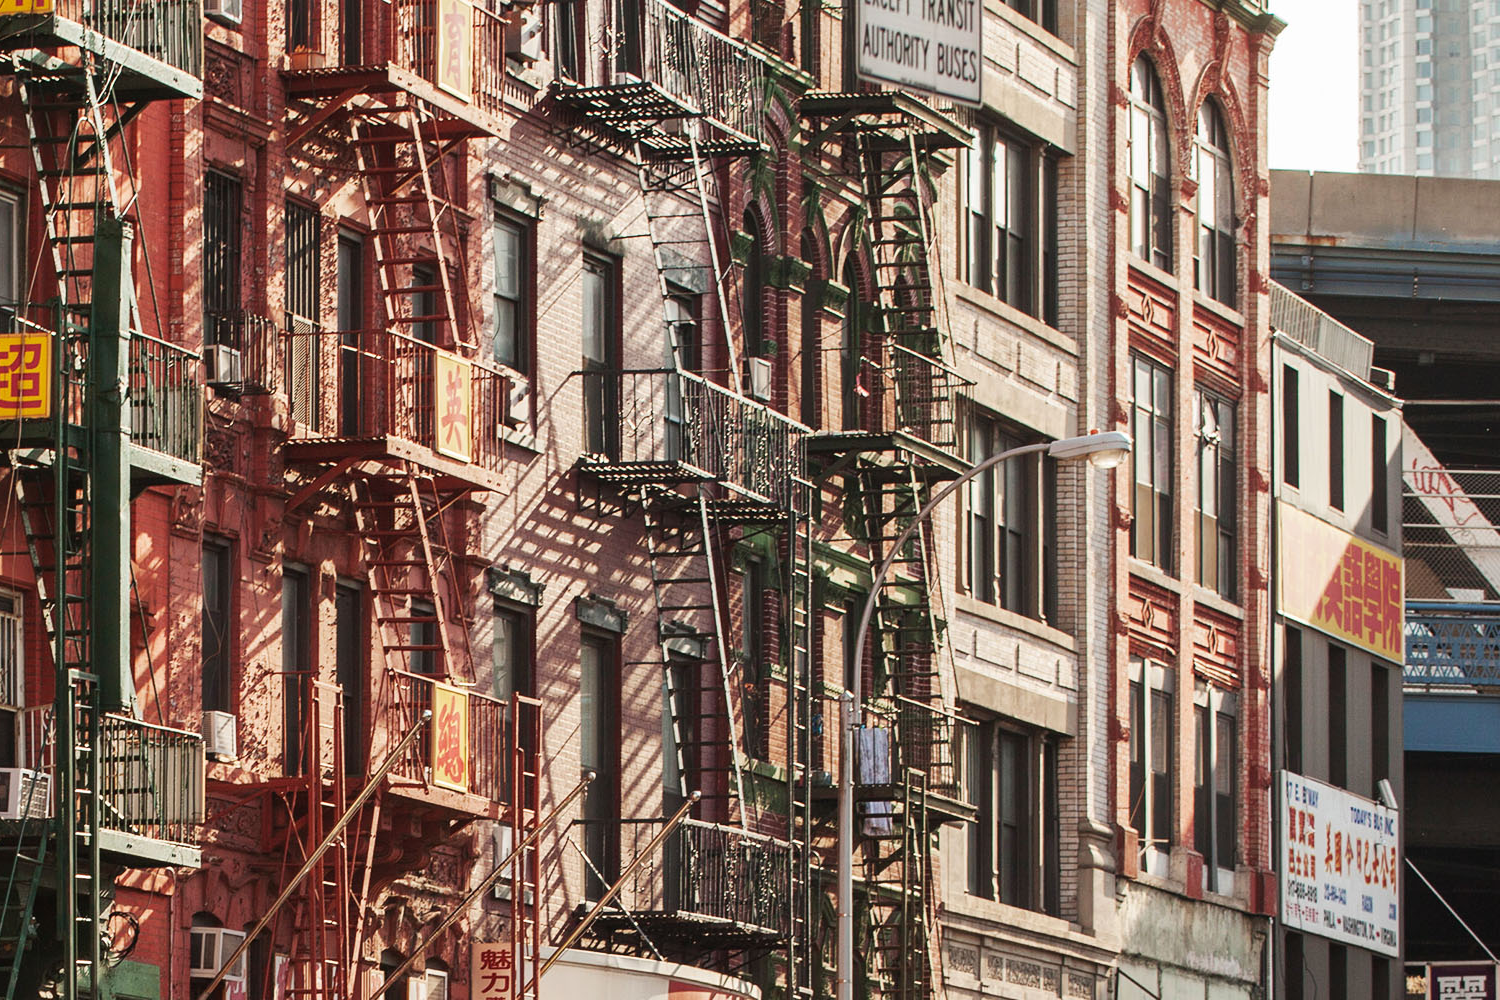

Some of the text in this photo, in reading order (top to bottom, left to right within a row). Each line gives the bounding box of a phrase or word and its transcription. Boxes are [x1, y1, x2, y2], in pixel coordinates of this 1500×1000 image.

[863, 24, 977, 83] AUTHORITY BUSES
[441, 366, 466, 451] 英
